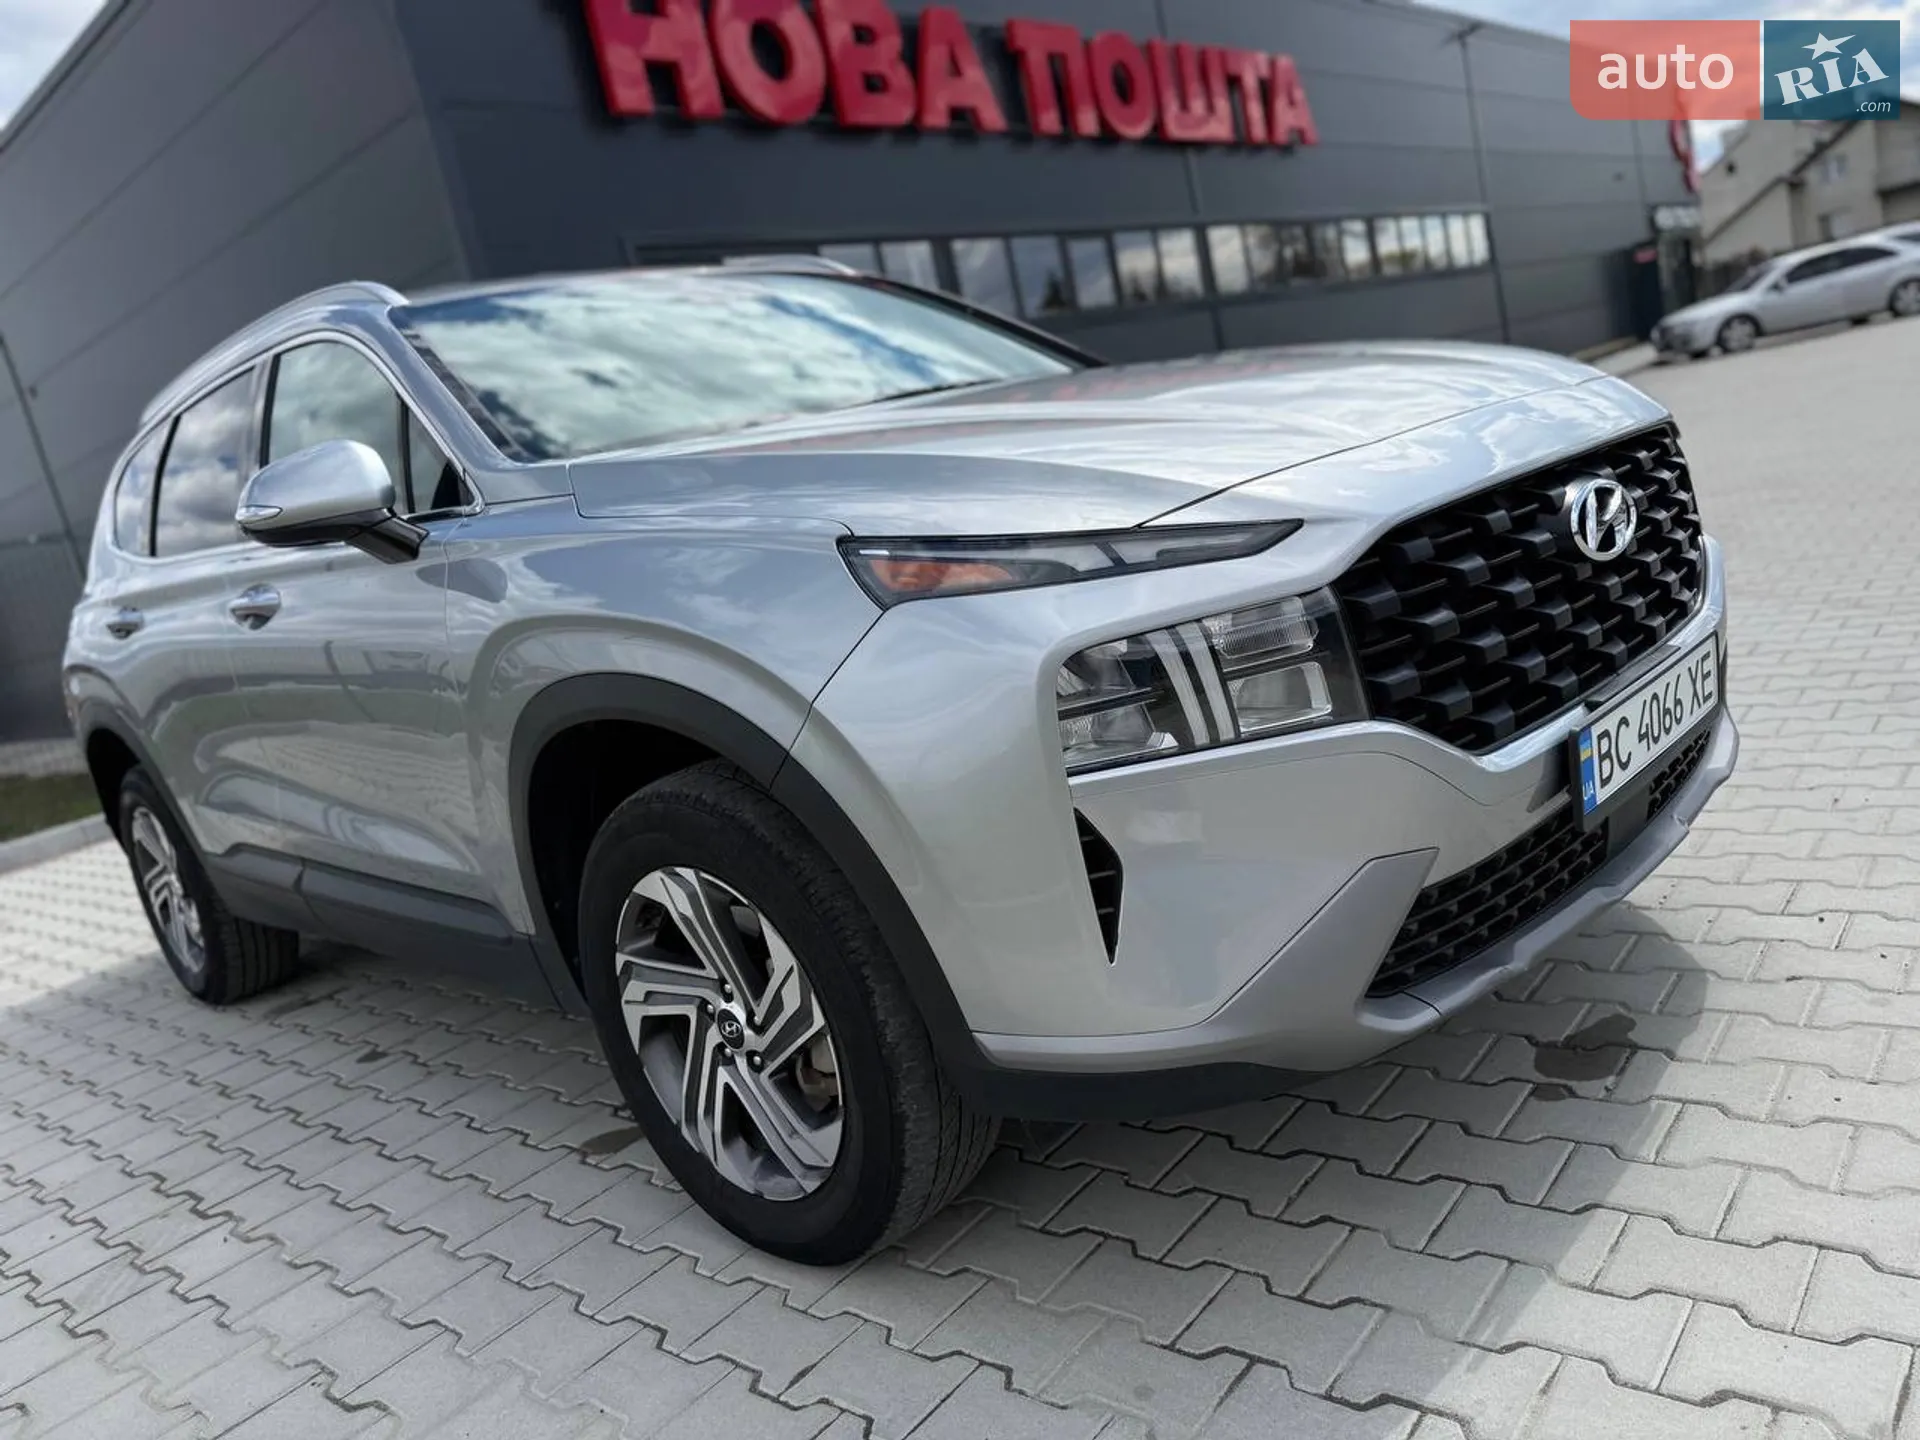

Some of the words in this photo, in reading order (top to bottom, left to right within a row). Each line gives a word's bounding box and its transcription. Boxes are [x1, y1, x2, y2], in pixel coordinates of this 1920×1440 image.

[587, 0, 1007, 132] НОВА
[1007, 19, 1318, 146] ПОШТА
[1597, 716, 1632, 789] BC
[1638, 673, 1684, 751] 4066
[1688, 650, 1713, 716] XE
